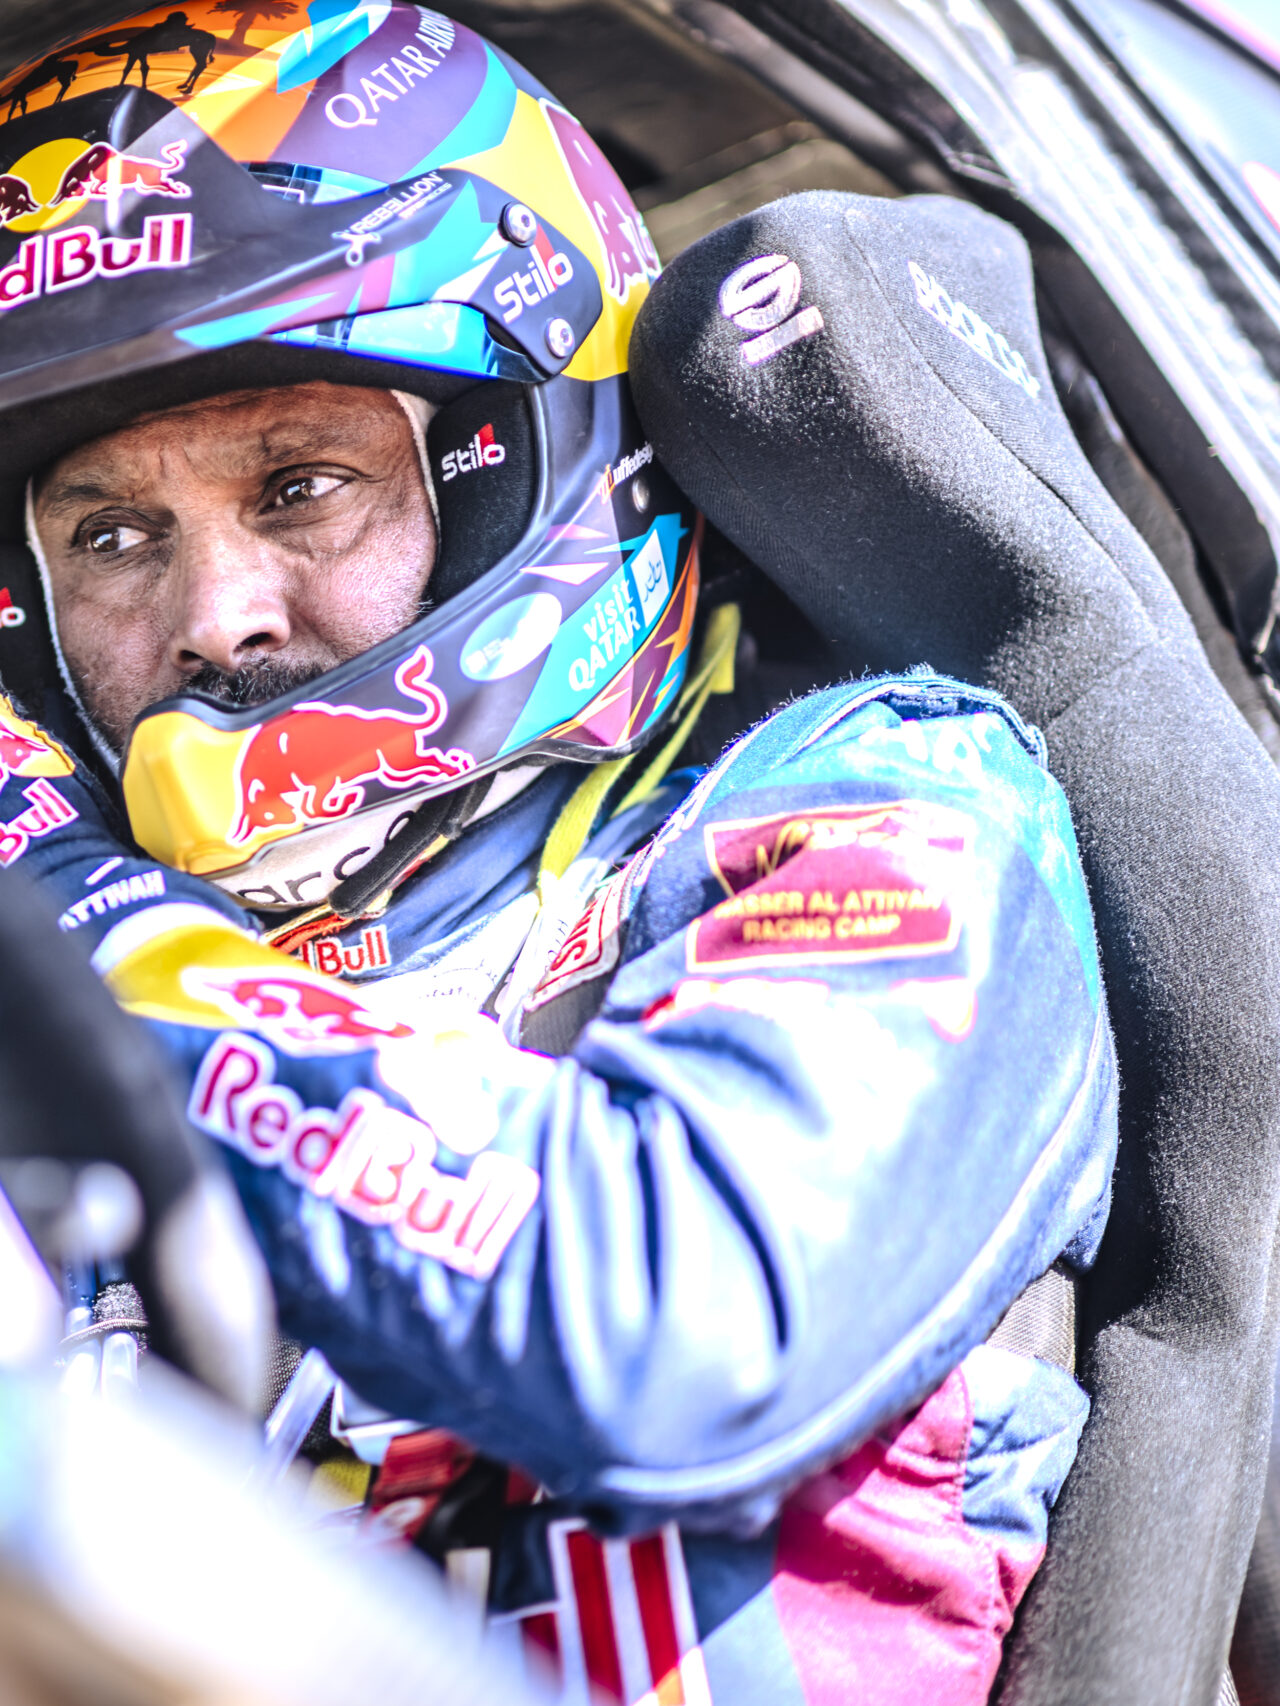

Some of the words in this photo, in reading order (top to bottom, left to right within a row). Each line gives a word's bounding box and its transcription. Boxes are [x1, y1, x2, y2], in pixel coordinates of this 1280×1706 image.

[325, 45, 440, 129] QATAR
[349, 171, 443, 234] REBELLION
[46, 213, 191, 293] Bull
[569, 606, 641, 692] QATAR
[742, 916, 831, 943] RACING
[834, 913, 902, 939] CAMP
[808, 889, 839, 913] AL
[314, 924, 391, 976] Bull
[191, 1034, 365, 1194] Red
[338, 1112, 534, 1273] Bull
